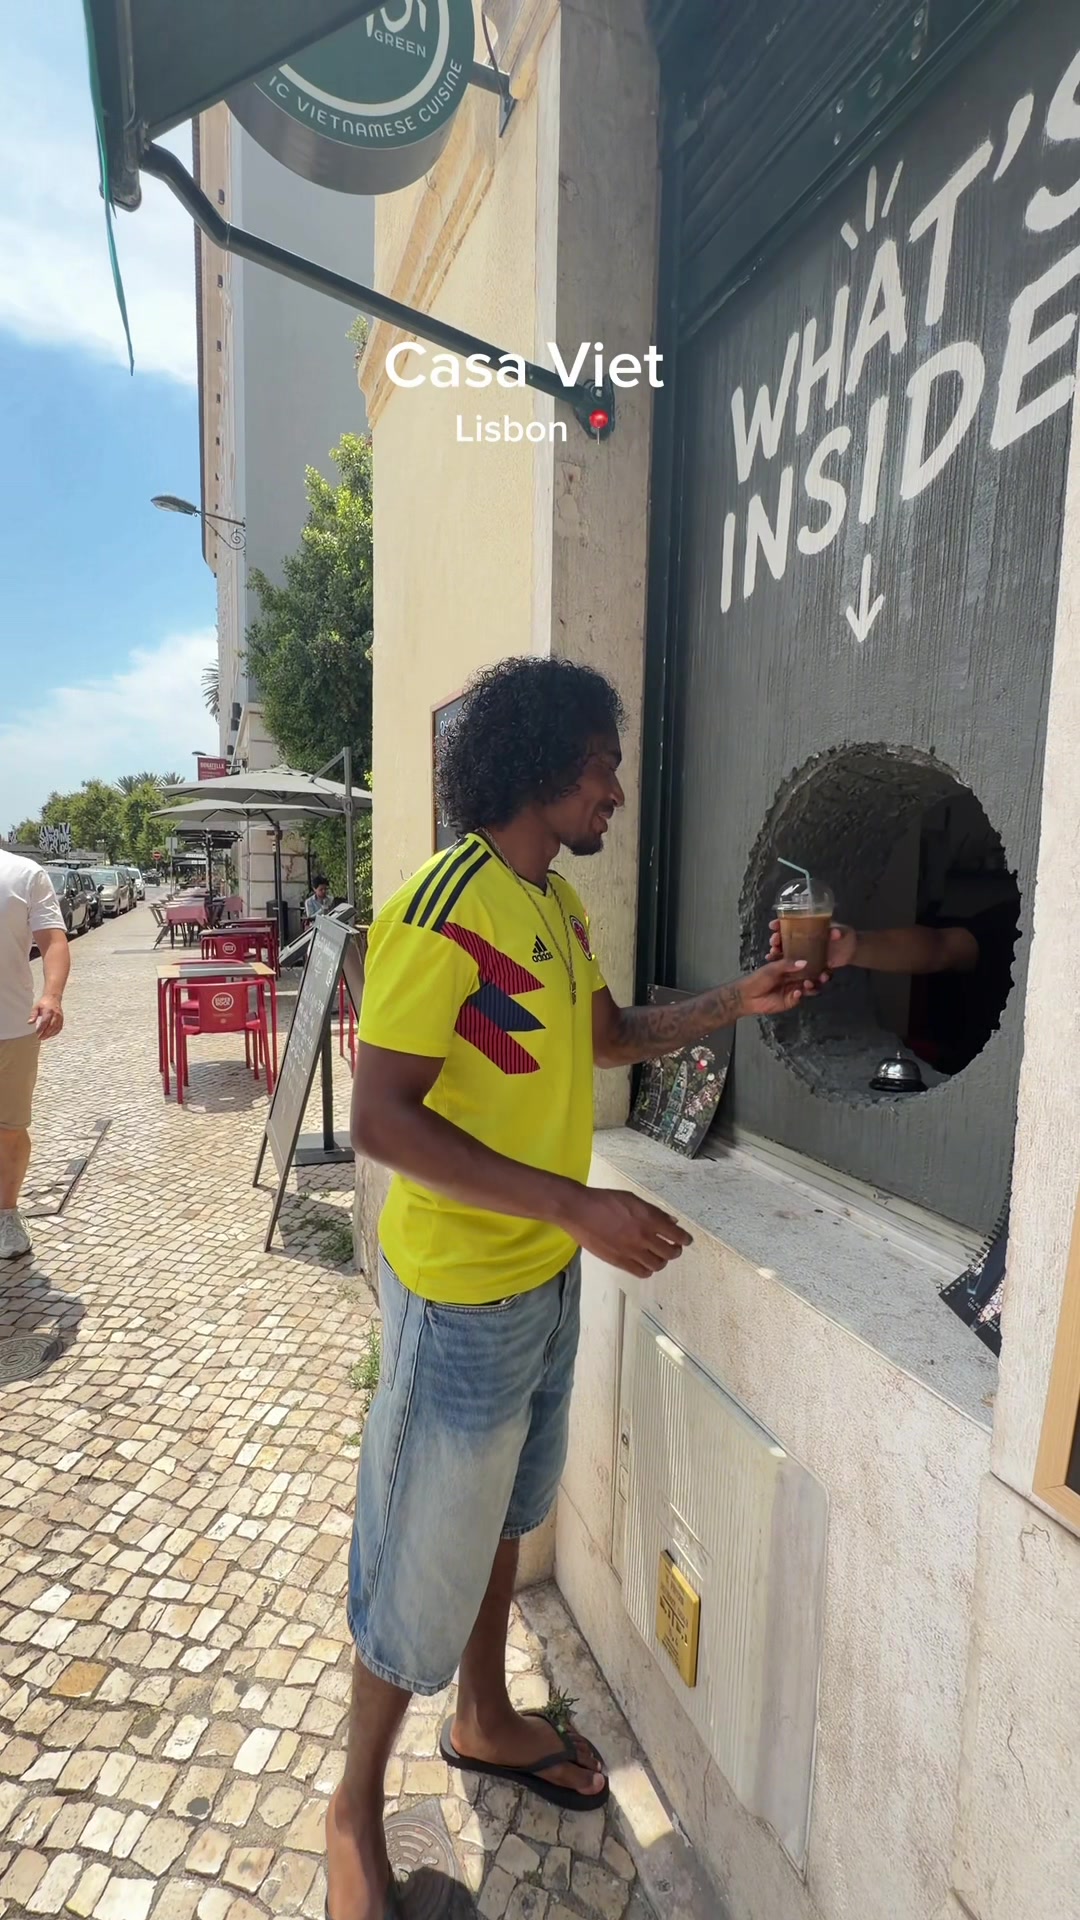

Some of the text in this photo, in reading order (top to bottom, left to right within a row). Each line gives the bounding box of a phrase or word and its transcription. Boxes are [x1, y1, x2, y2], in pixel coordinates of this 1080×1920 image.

[374, 30, 426, 58] GREEN
[268, 58, 463, 138] IC VIETNAMESE CUISINE
[720, 246, 1080, 613] INSIDE
[532, 951, 553, 962] adidas
